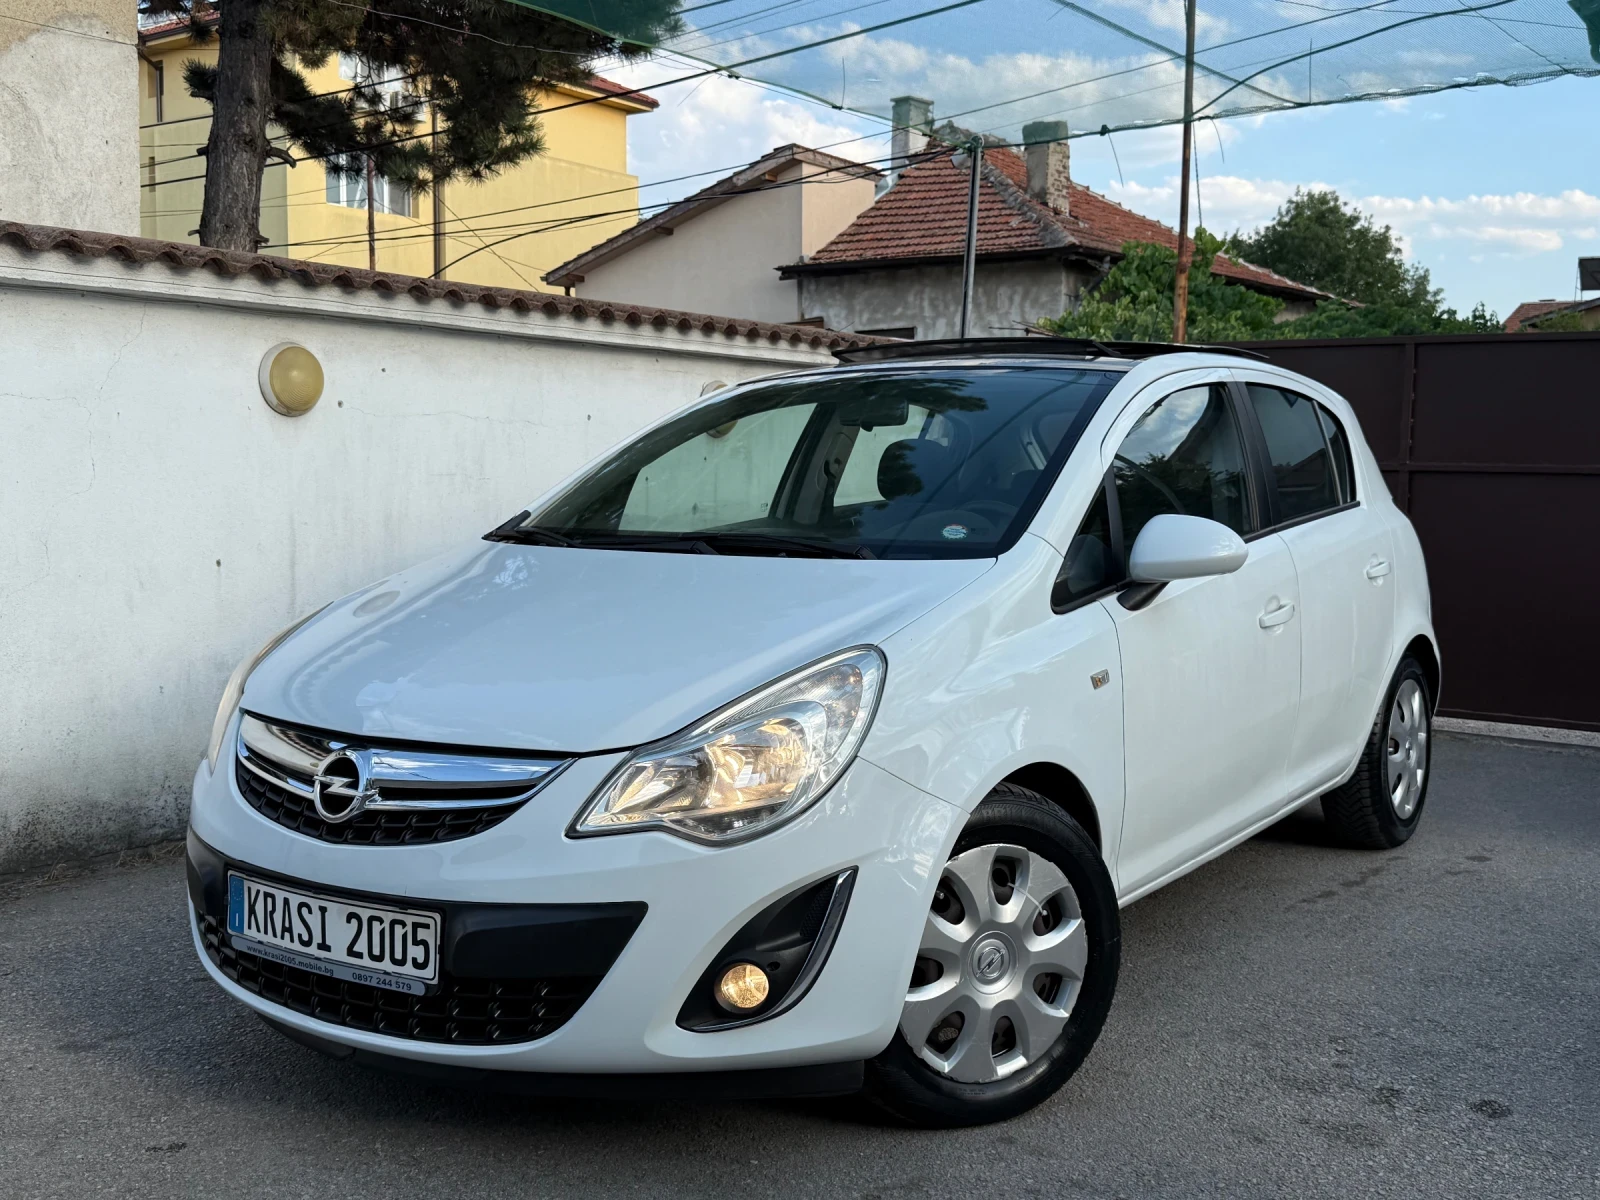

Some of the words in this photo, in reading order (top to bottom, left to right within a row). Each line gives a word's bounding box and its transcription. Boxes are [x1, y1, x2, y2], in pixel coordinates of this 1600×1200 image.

[247, 885, 332, 953] KRASI
[345, 911, 431, 971] 2005
[352, 972, 373, 983] 0897
[376, 976, 393, 988] 244
[395, 981, 412, 991] 579
